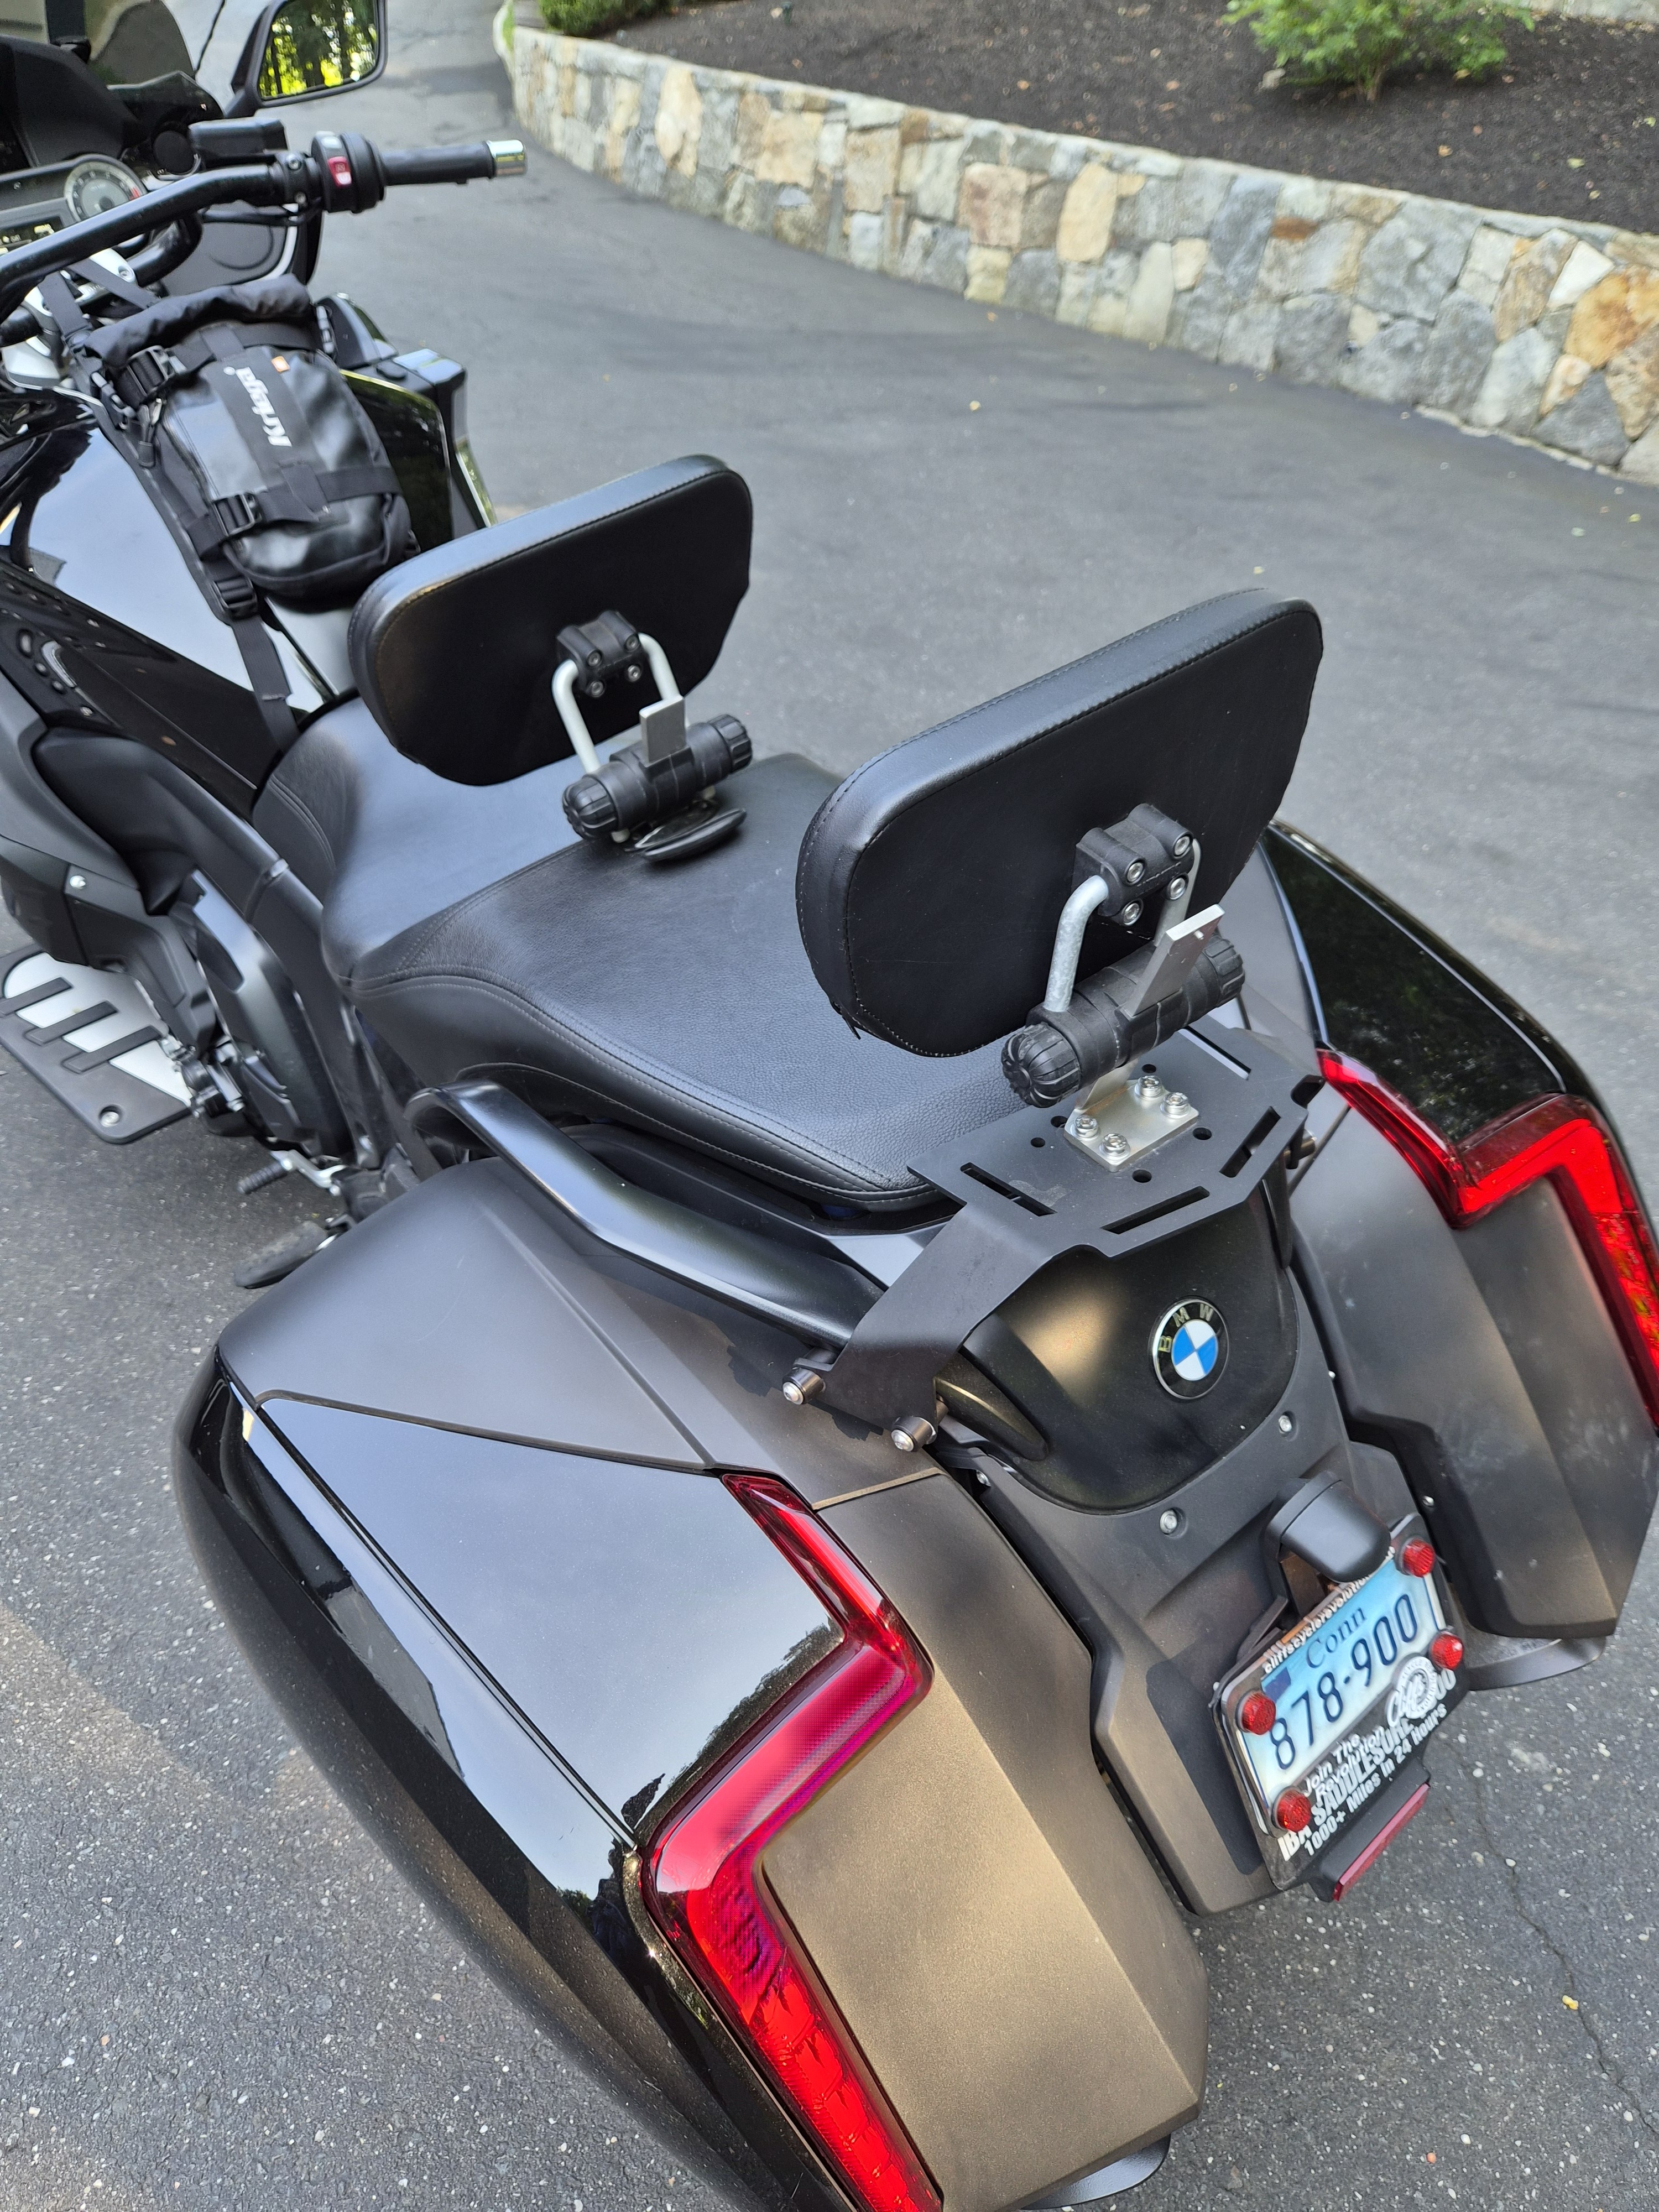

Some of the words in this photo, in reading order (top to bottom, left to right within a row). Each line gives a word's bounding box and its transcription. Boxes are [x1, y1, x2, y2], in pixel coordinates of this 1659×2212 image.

[234, 366, 292, 447] Kriega
[1158, 1303, 1214, 1353] BMW
[1307, 1607, 1366, 1668] Conn
[1270, 1593, 1418, 1770] 878-900
[1302, 1761, 1333, 1797] Join
[1331, 1733, 1361, 1764] The
[1304, 1809, 1347, 1856] 1000+
[1345, 1771, 1381, 1813] Miles
[1394, 1738, 1412, 1764] 24
[1410, 1702, 1448, 1746] Hours
[1314, 1724, 1385, 1807] Revolution
